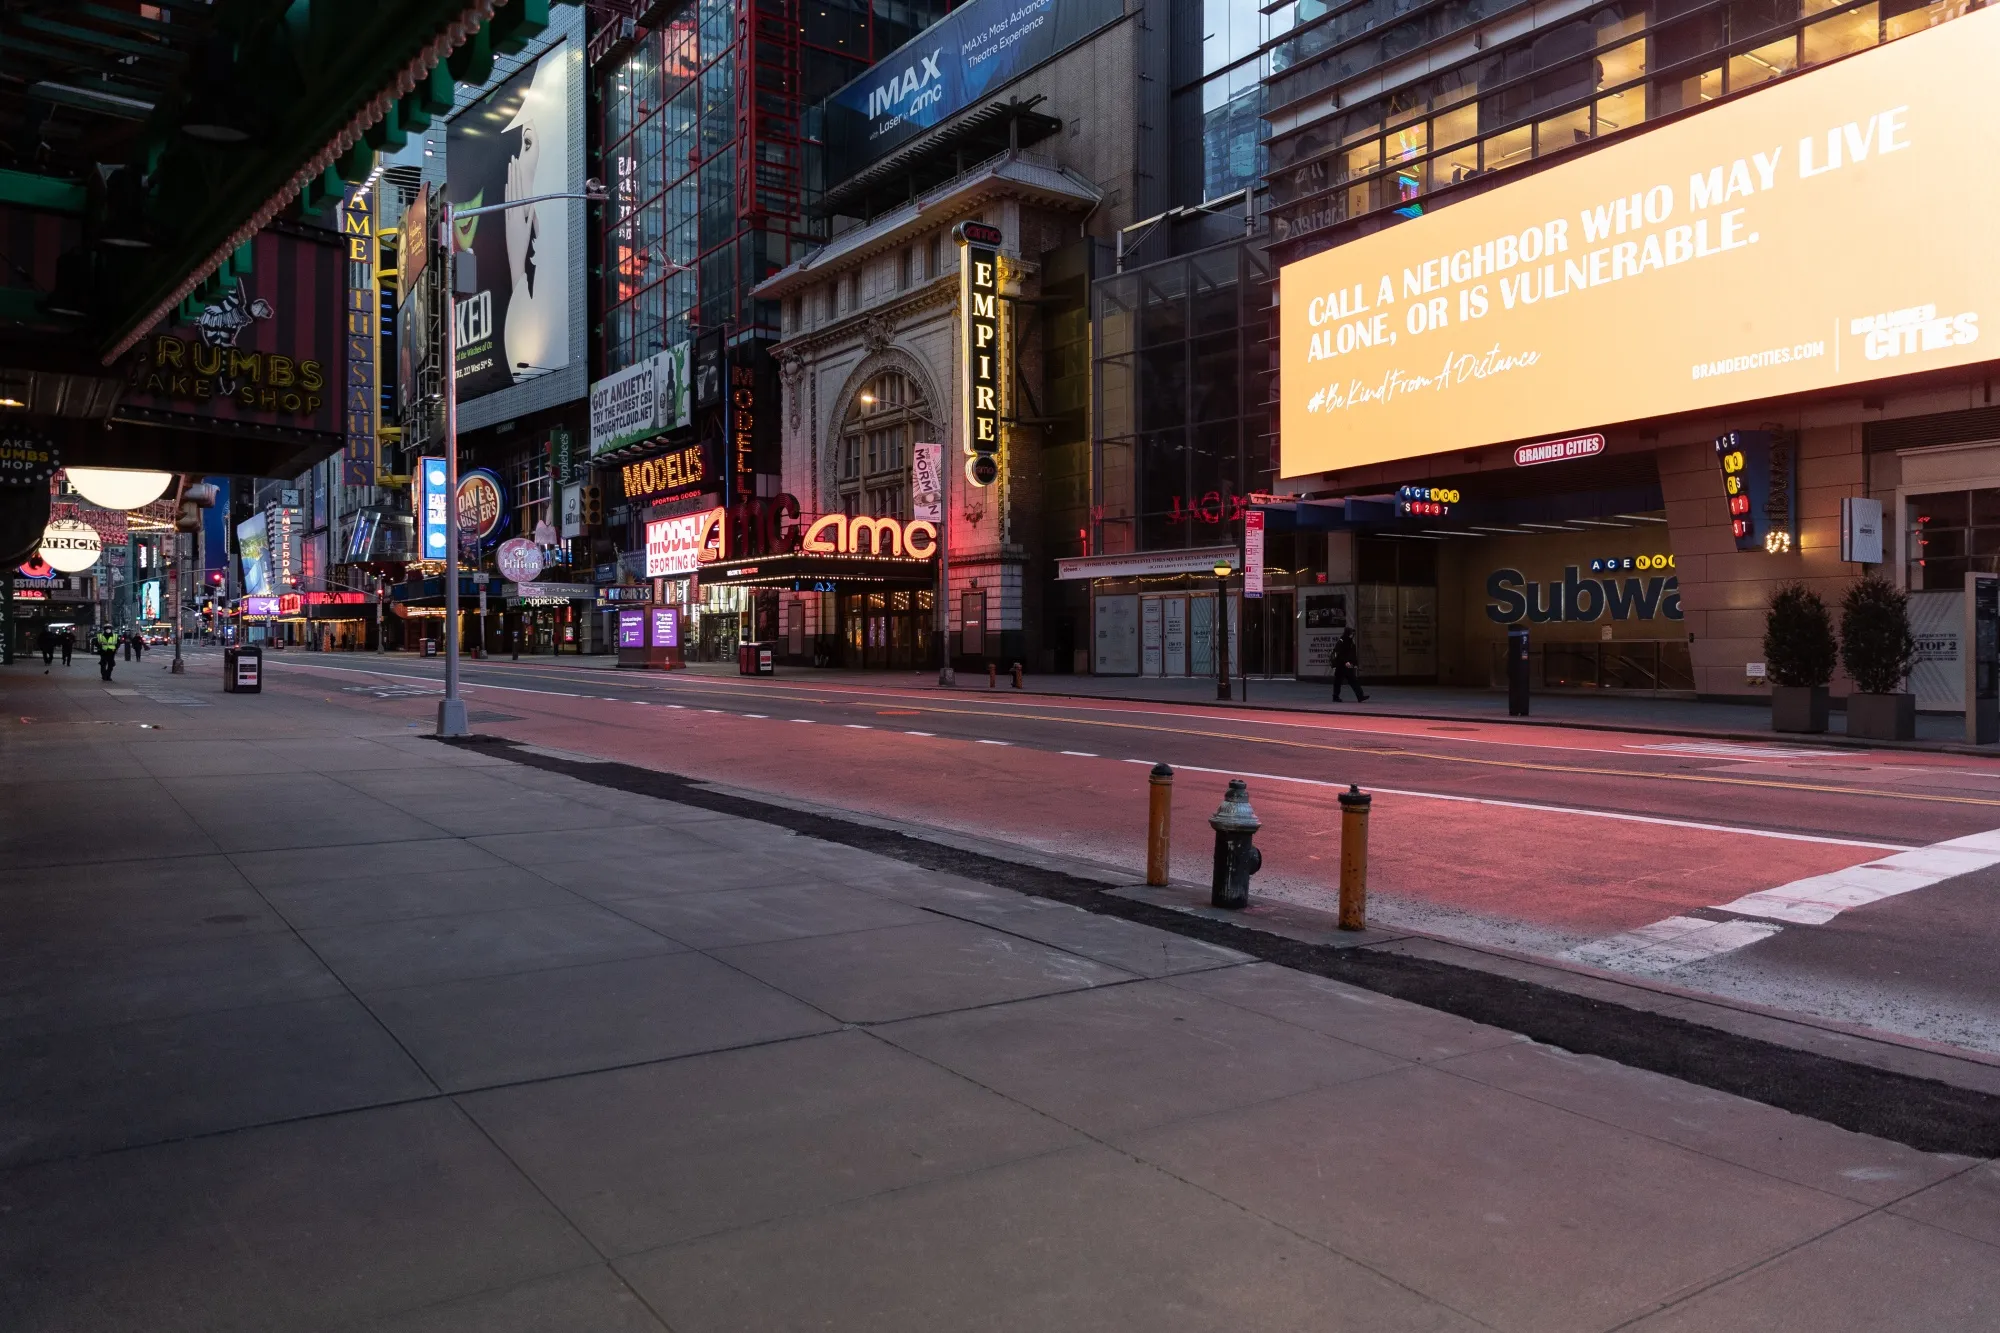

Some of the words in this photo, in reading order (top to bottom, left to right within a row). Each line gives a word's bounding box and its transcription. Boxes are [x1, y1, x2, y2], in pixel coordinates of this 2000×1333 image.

[962, 32, 988, 56] IMAX's
[989, 18, 1009, 38] Most
[968, 44, 998, 68] Theatre
[999, 16, 1044, 49] Experience
[869, 47, 942, 120] IMAX
[880, 114, 902, 135] Laser
[910, 84, 942, 116] amc
[345, 190, 371, 260] AME
[967, 225, 1001, 243] amc
[1308, 284, 1370, 327] CALL
[1376, 275, 1394, 307] A
[1403, 219, 1568, 298] NEIGHBOR
[1581, 184, 1673, 244] WHO
[1690, 146, 1782, 213] MAY
[1799, 105, 1911, 179] LIVE
[1307, 313, 1397, 363] ALONE,
[1406, 297, 1449, 335] OR
[1459, 285, 1489, 322] IS
[1499, 207, 1760, 310] VULNERABLE.
[973, 261, 996, 442] EMPIRE
[1865, 311, 1979, 360] CITIES
[141, 335, 325, 391] RUMBS
[1692, 341, 1824, 380] BRANDEDCITIES.COM
[135, 374, 212, 398] AKE
[241, 385, 322, 413] SHOP
[348, 289, 371, 485] TUSSAUDS
[593, 388, 609, 411] GOT
[610, 370, 653, 404] ANXIETY?
[593, 411, 603, 425] TRY
[605, 407, 615, 419] THE
[616, 395, 640, 414] PUREST
[640, 390, 653, 406] CBD
[593, 405, 653, 438] THOUGHTCLOUD.NET
[732, 364, 754, 499] MODELL
[556, 433, 570, 487] Applebee's
[622, 445, 702, 497] MODELL'S
[976, 464, 994, 474] amc
[1519, 443, 1564, 463] BRANDED
[1566, 437, 1599, 456] CITIES
[485, 485, 495, 501] &
[652, 495, 679, 507] SPORTING
[680, 490, 701, 500] GOODS
[282, 507, 291, 585] AMSTERDAM
[803, 514, 936, 558] amc
[504, 559, 539, 571] Hilton
[649, 553, 688, 574] SPORTING
[524, 595, 570, 607] Applebee's
[795, 581, 837, 592] IAX
[1486, 565, 1684, 625] Subwa
[1920, 641, 1945, 650] TOP
[1949, 641, 1957, 650] 2
